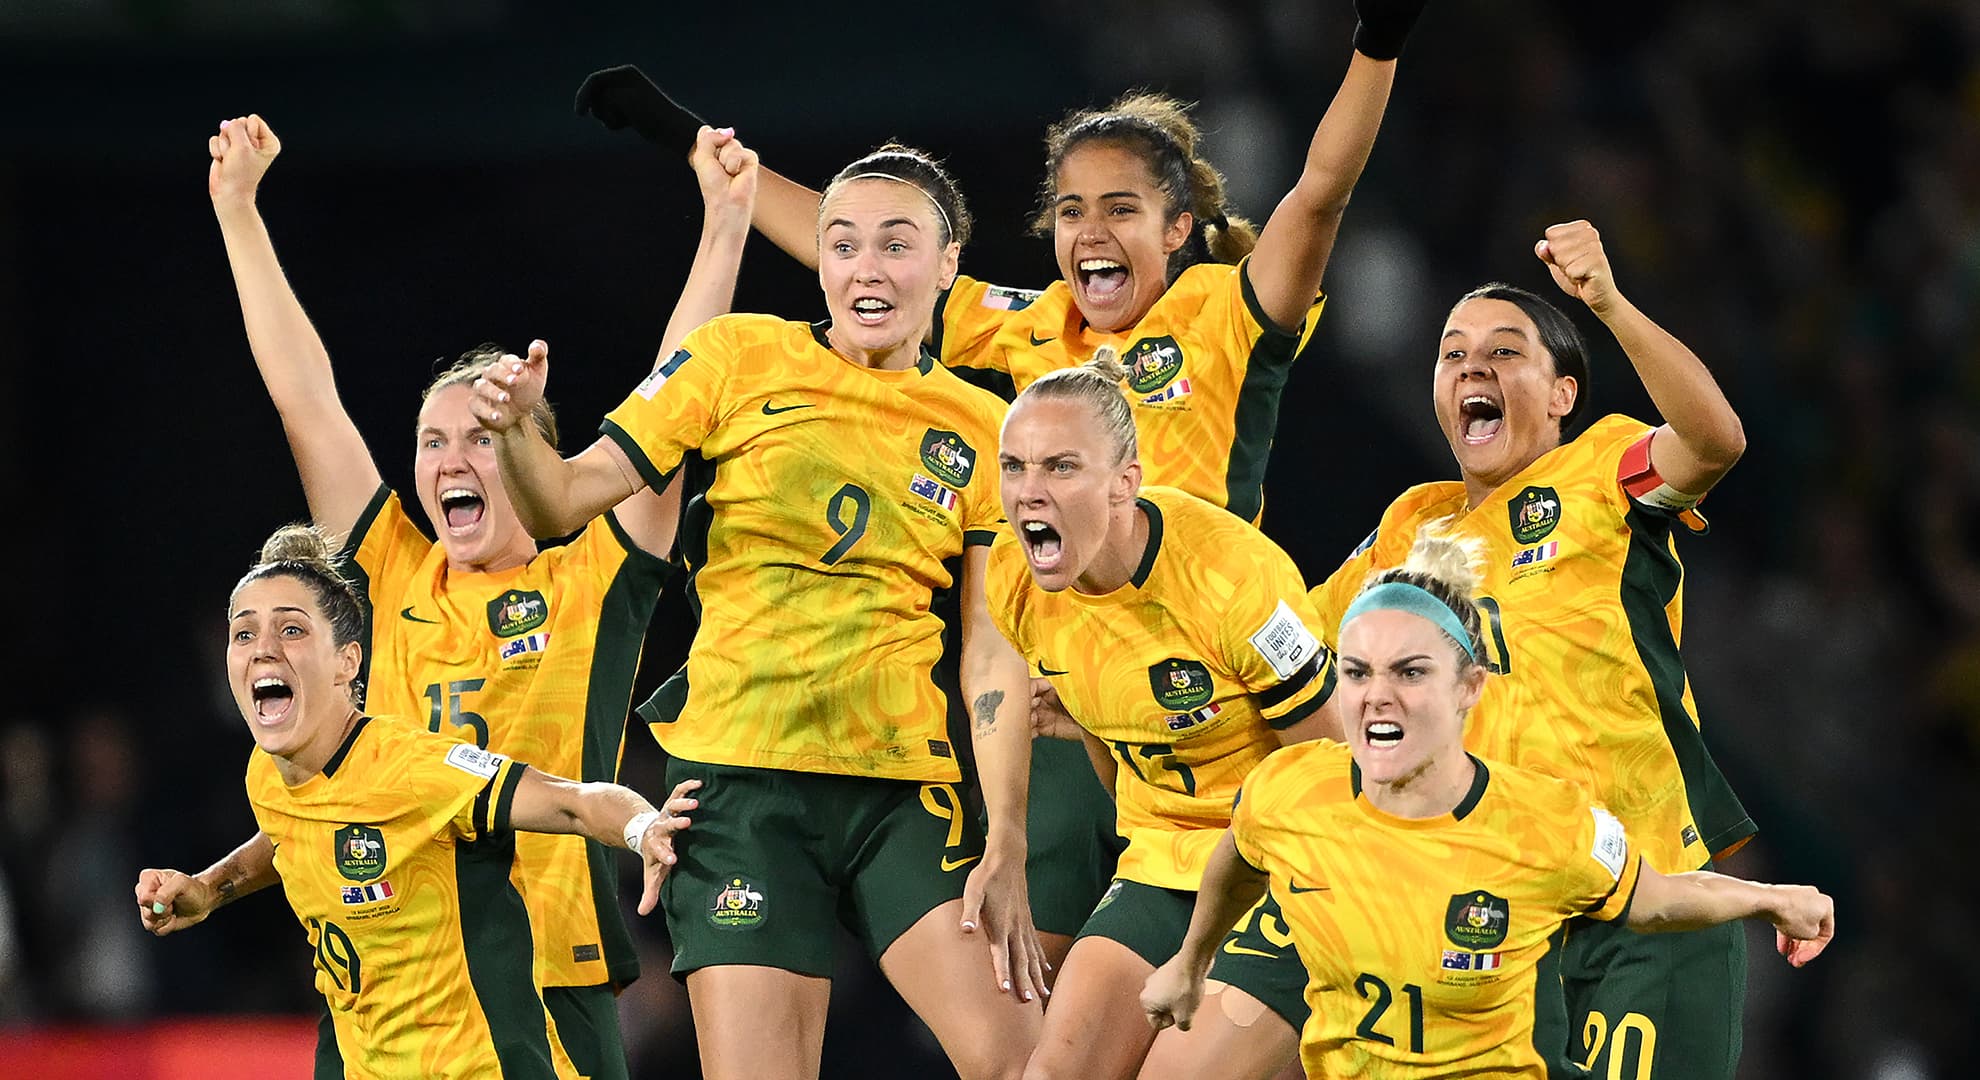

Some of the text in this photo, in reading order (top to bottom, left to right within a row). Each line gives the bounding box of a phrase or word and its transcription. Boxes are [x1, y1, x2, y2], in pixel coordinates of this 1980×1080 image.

[1139, 363, 1176, 385] AUSTRALIA
[927, 455, 961, 478] AUSTRALIA
[818, 482, 871, 566] 9
[1521, 517, 1554, 532] AUSTRALIA
[501, 613, 539, 630] AUSTRALIA
[1265, 617, 1288, 644] FOOTBALL
[1270, 622, 1294, 651] UNITES
[1164, 685, 1205, 698] AUSTRALIA
[423, 677, 489, 751] 15
[919, 784, 964, 848] 9
[1455, 925, 1497, 935] AUSTRALIA
[309, 917, 361, 994] 19
[1353, 972, 1425, 1055] 21
[1572, 1010, 1657, 1080] 20
